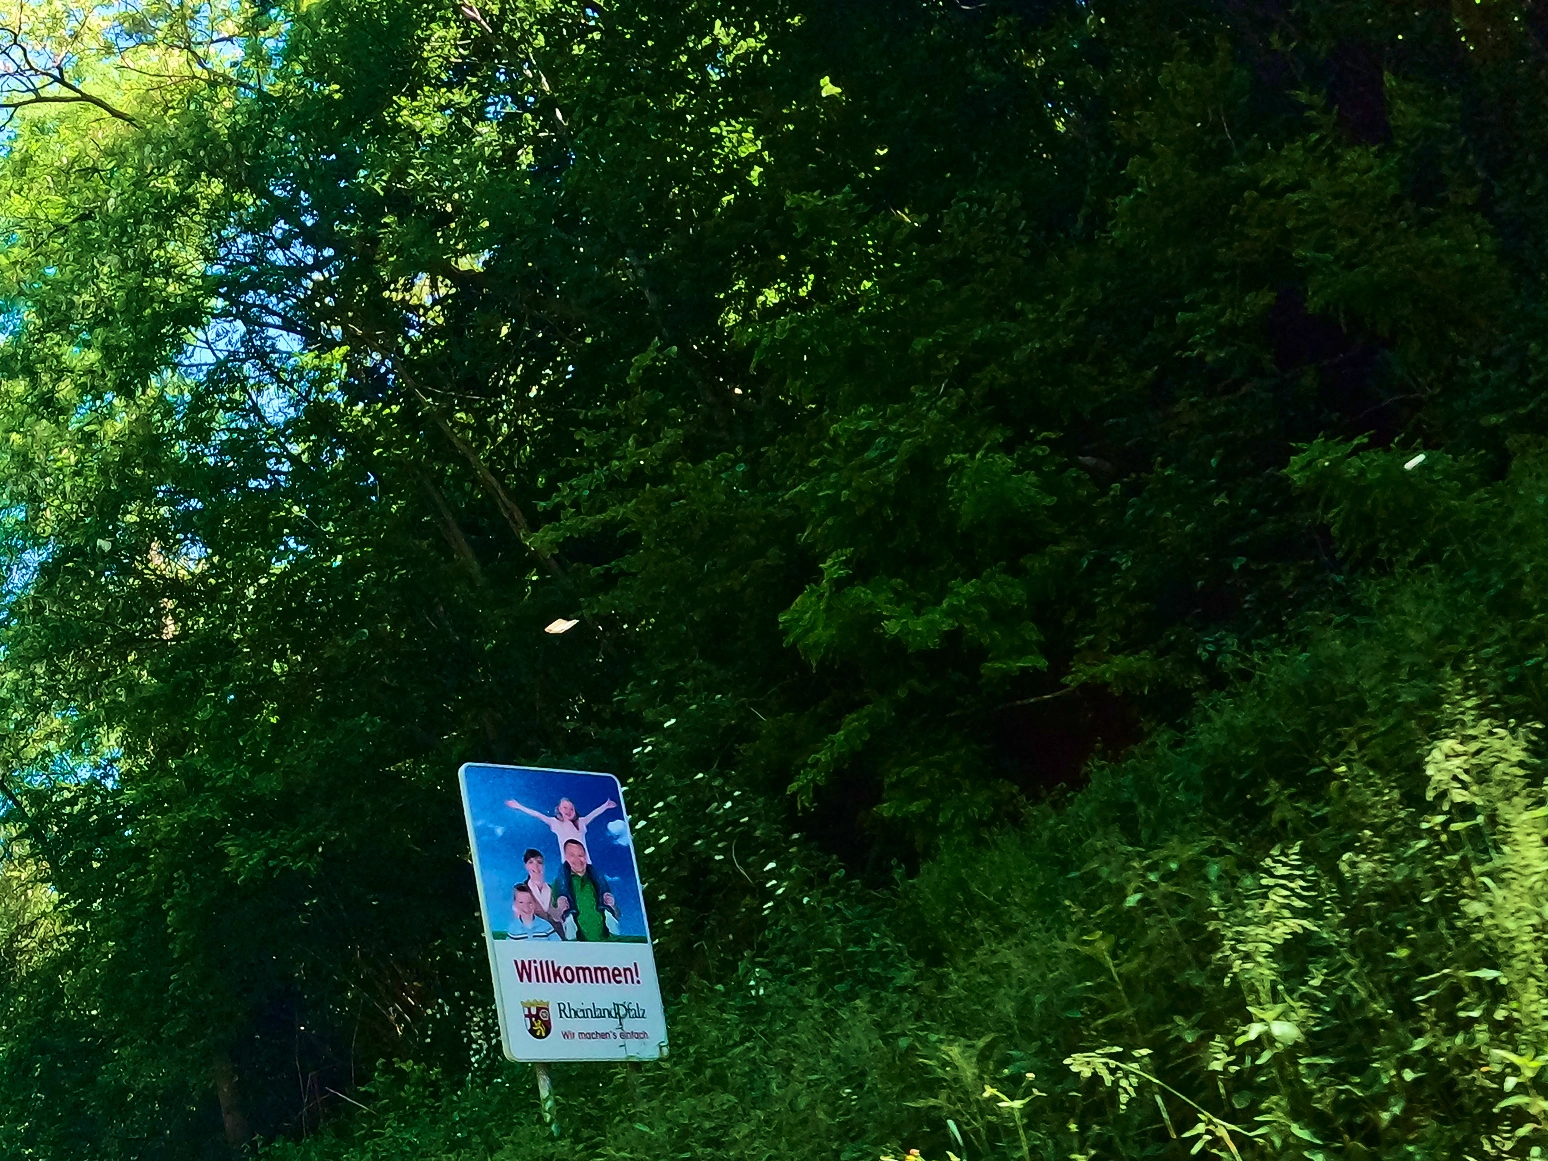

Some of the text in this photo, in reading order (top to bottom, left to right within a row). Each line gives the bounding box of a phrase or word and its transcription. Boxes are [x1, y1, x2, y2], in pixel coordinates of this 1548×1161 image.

[513, 959, 642, 985] Willkommen!
[561, 1030, 649, 1040] Wir machen's einfach
